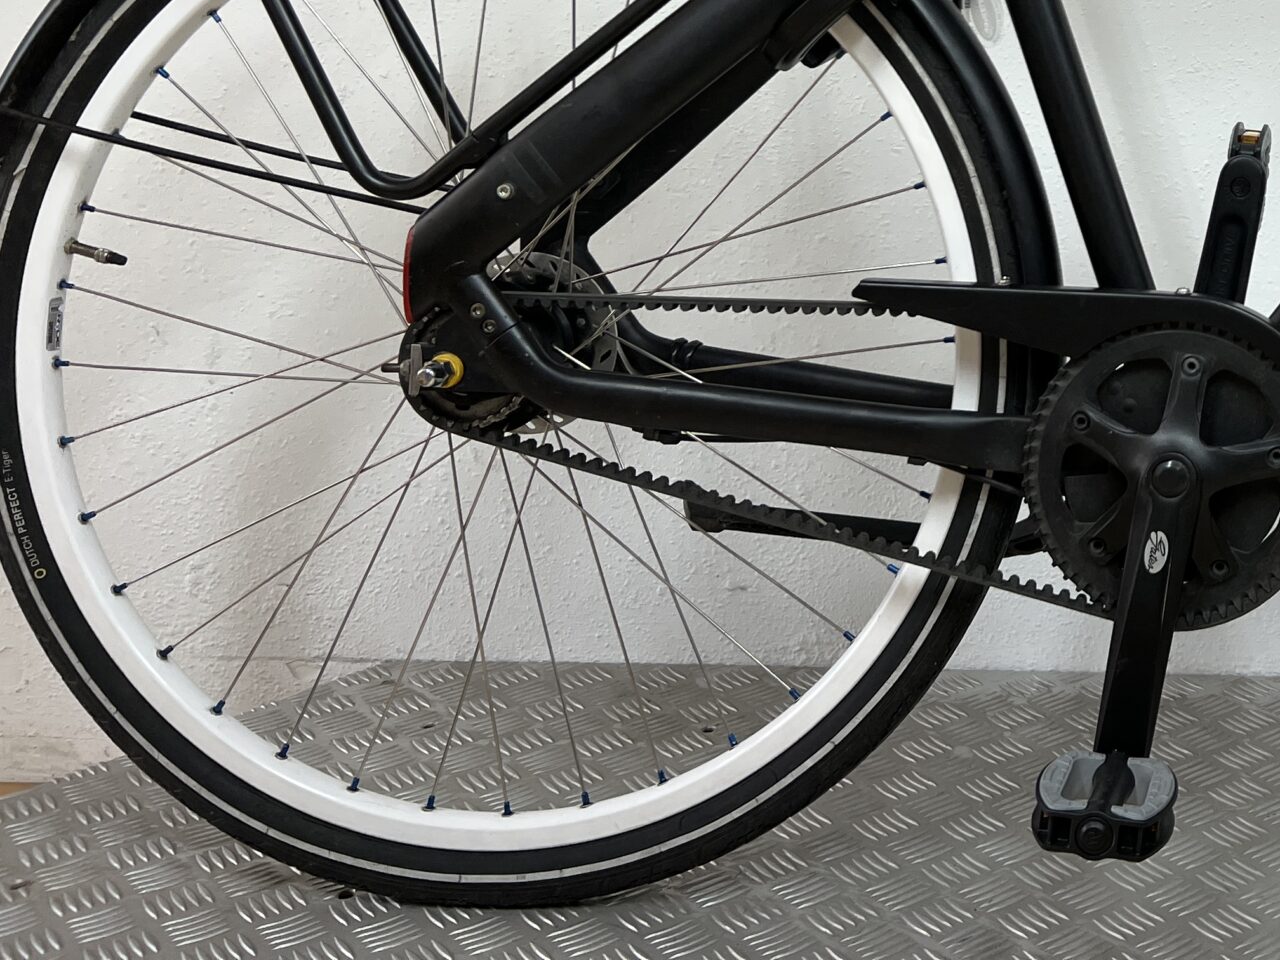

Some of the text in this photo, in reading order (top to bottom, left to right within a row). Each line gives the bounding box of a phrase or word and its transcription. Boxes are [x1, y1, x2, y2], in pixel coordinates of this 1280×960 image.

[2, 451, 40, 567] DUTCH PERFECT E-Tiger
[1146, 532, 1166, 571] Gates
